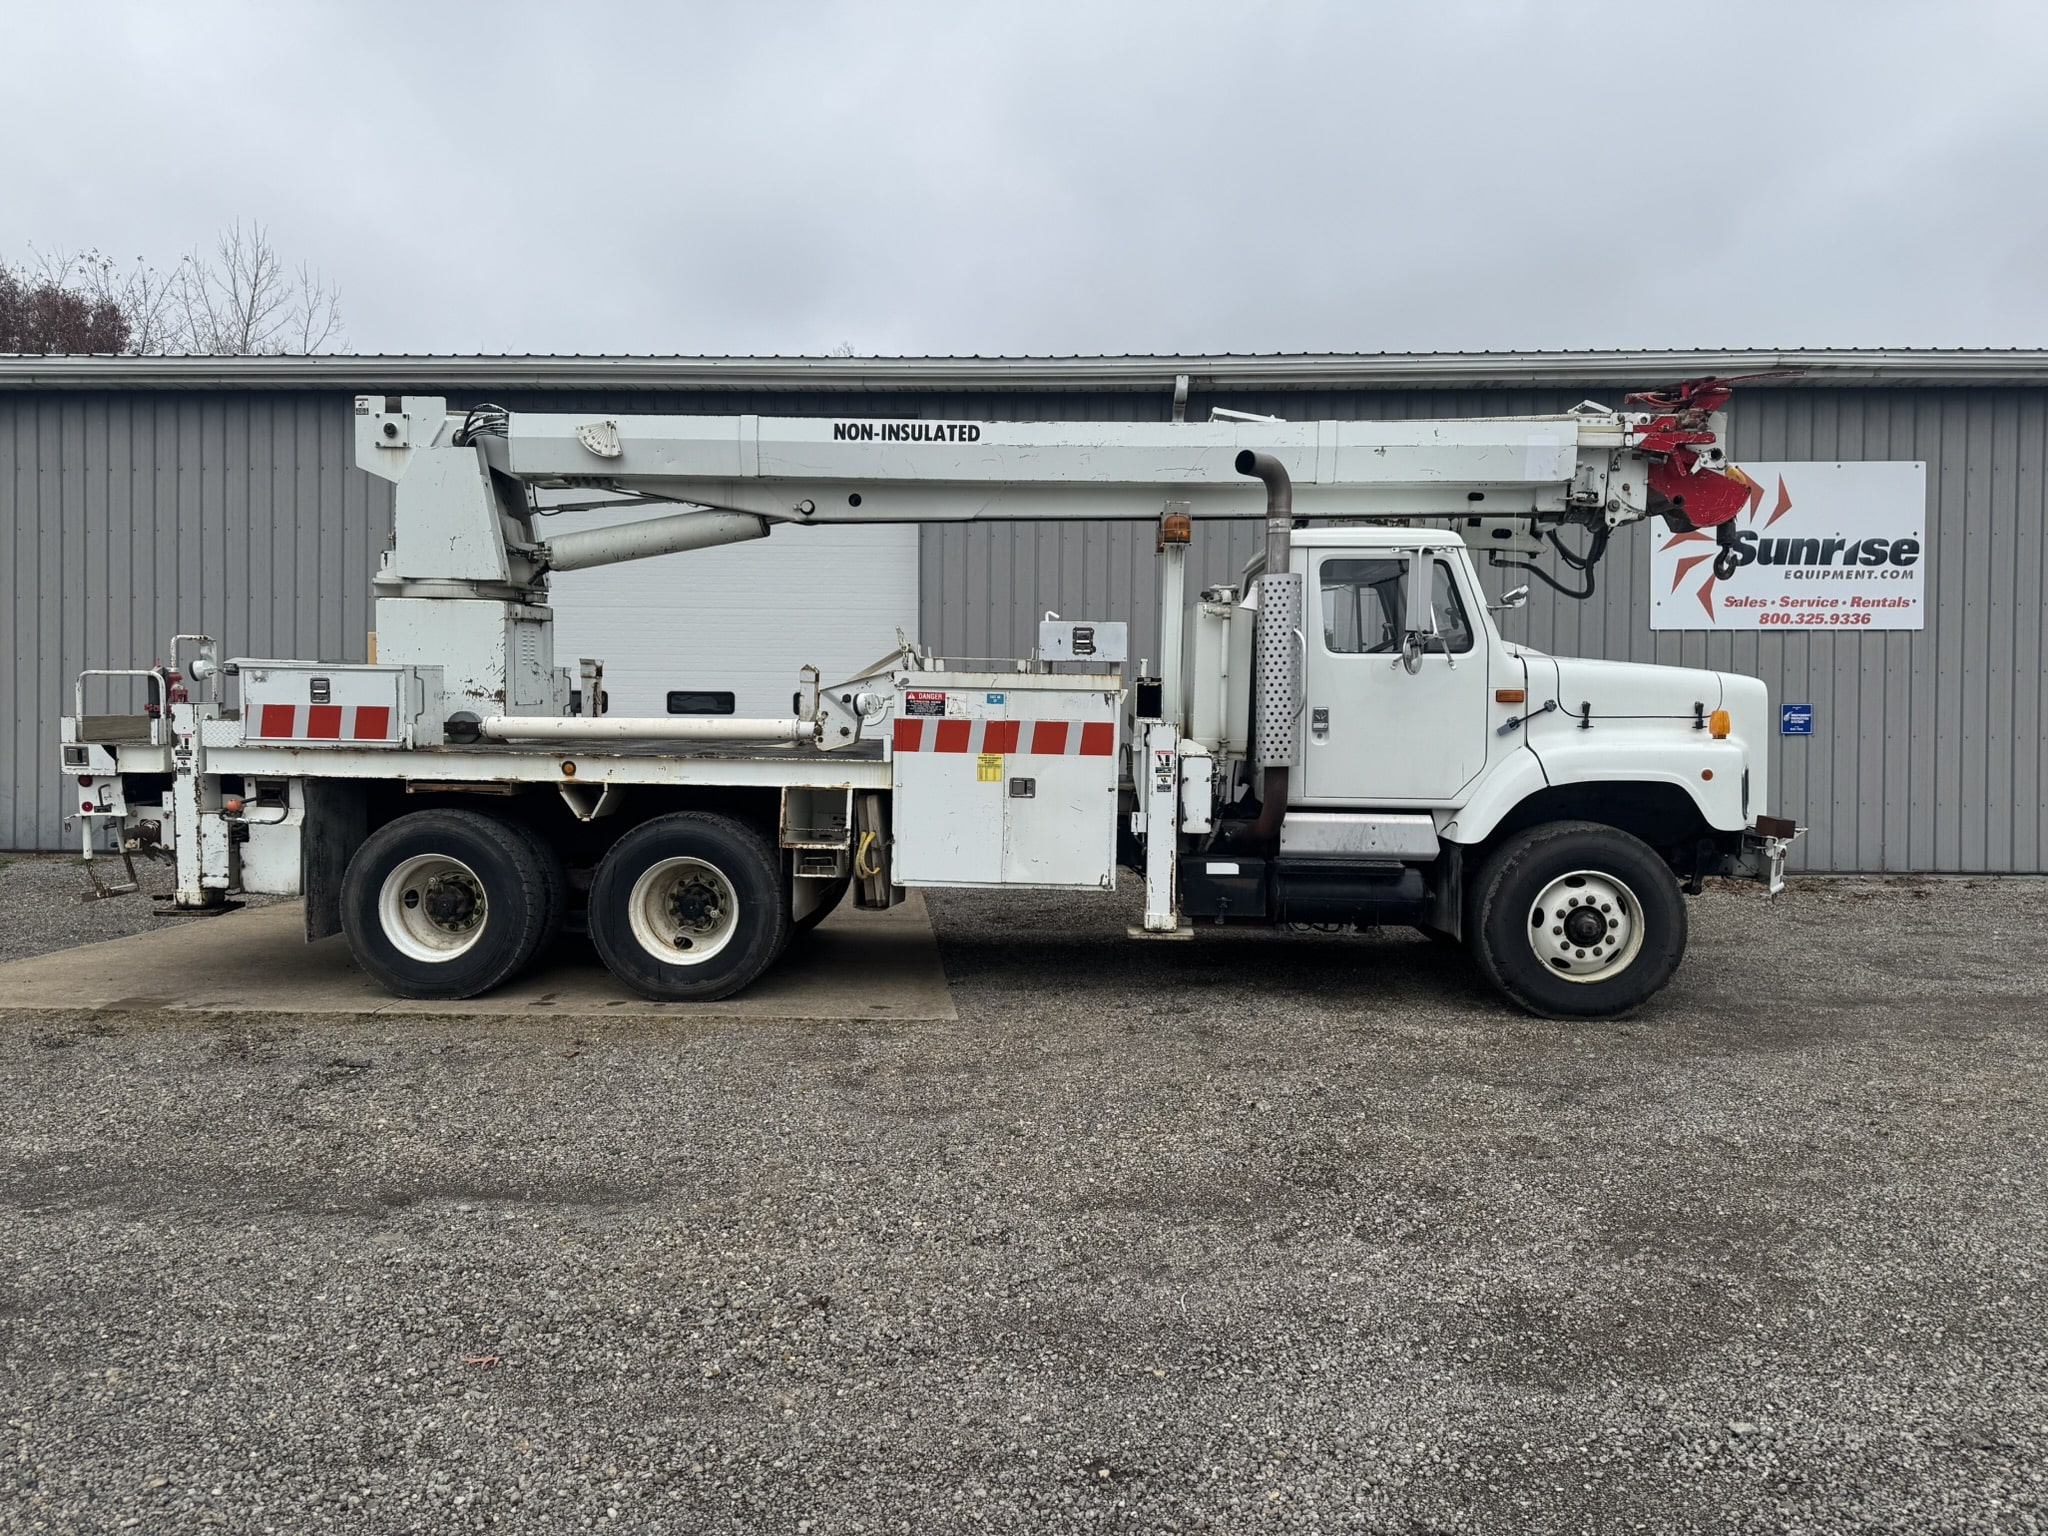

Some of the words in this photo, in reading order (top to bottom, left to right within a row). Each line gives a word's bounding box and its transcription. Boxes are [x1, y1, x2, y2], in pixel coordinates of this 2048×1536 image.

[834, 423, 980, 442] NON-INSULATED
[1734, 530, 1920, 566] Sunrise
[1784, 569, 1914, 580] EQUIPMENT.COM
[1724, 596, 1768, 608] Sales
[1779, 596, 1839, 608] Service
[1850, 596, 1910, 608] Rentals
[1759, 613, 1871, 625] 800.325.9336
[918, 692, 943, 700] DANGER
